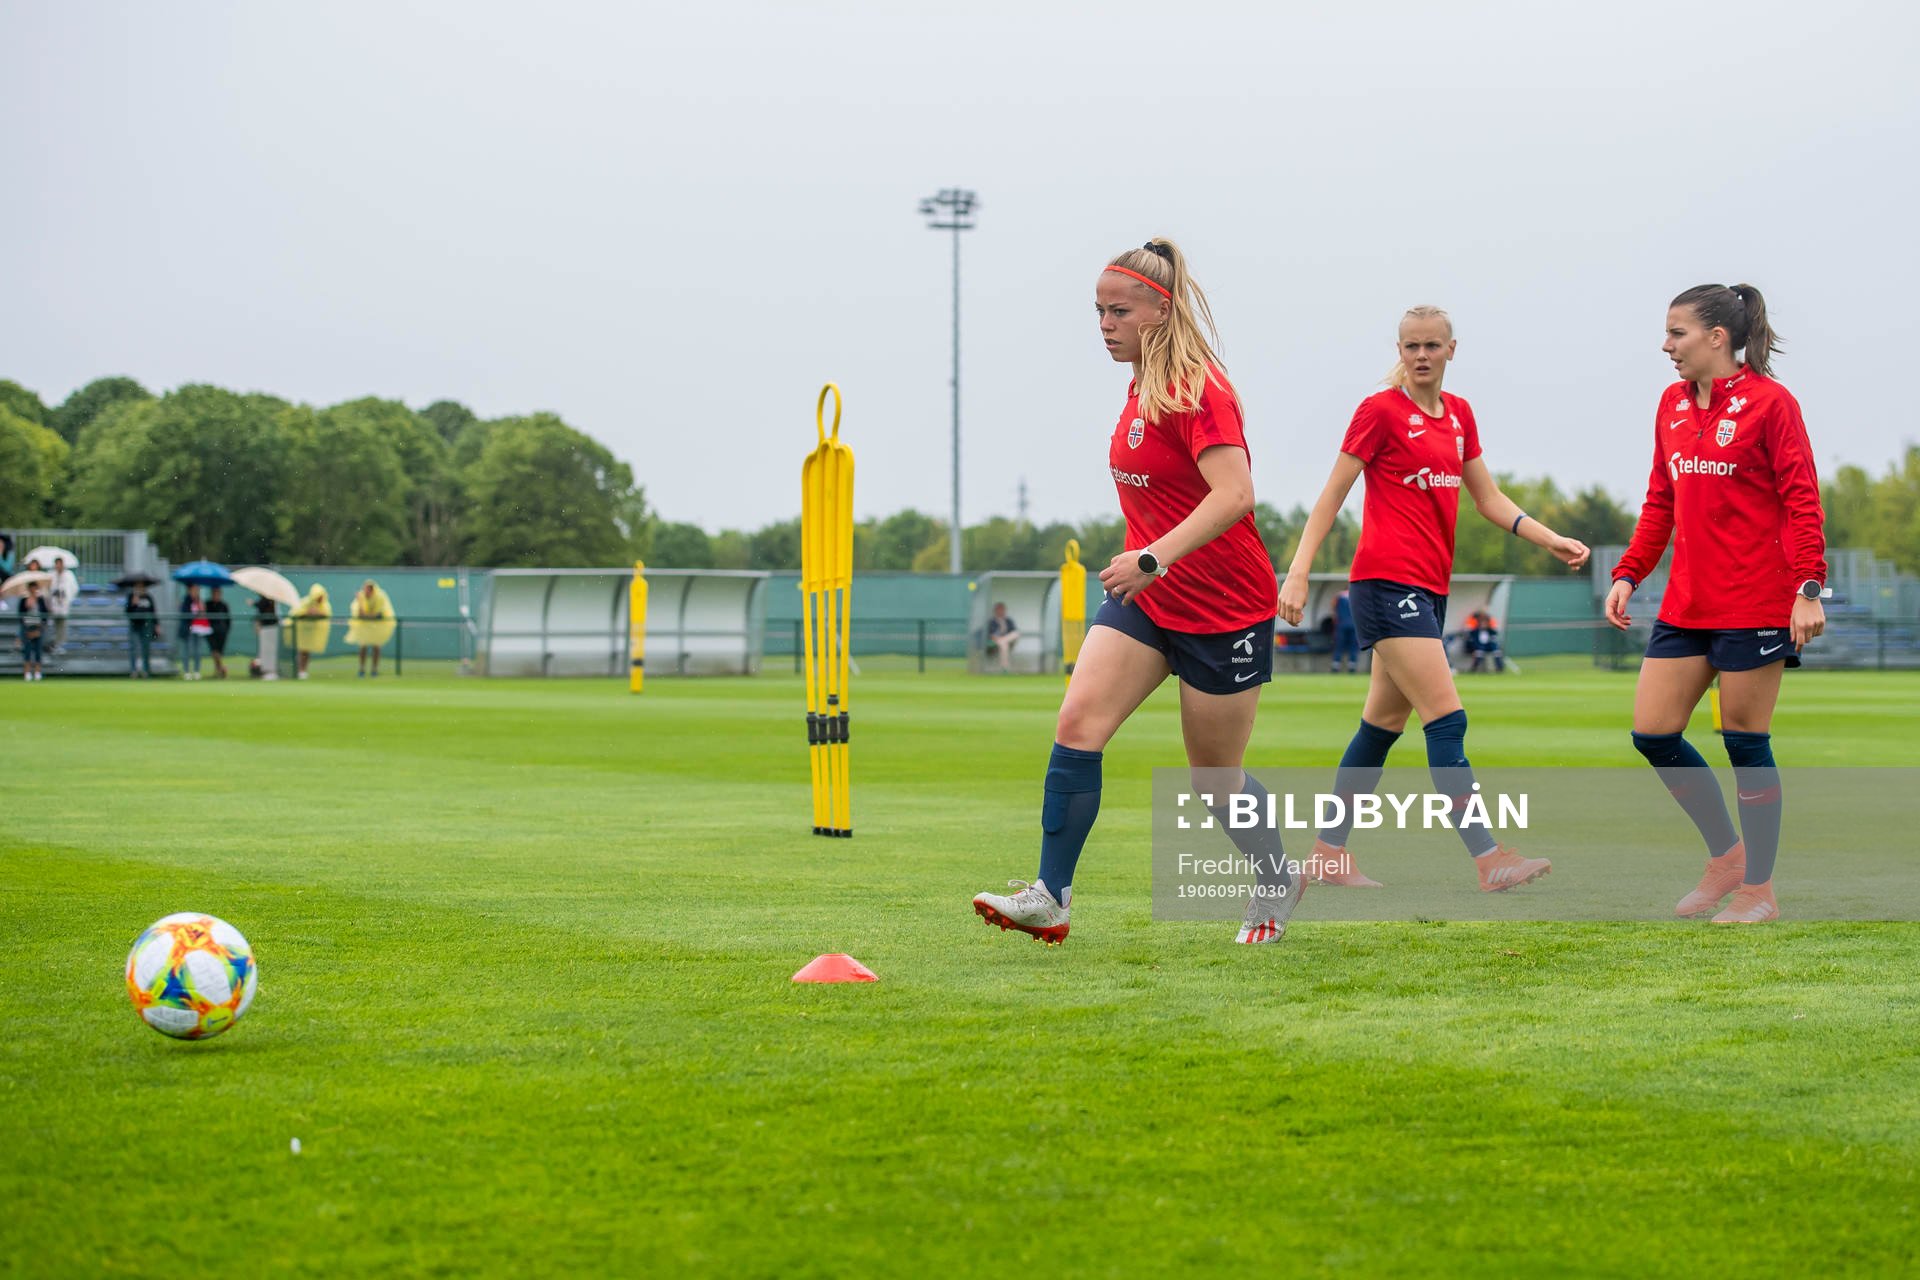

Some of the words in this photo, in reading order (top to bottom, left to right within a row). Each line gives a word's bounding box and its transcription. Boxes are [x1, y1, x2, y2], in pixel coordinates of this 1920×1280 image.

[1678, 455, 1738, 476] telenor
[1757, 629, 1779, 637] telenor
[1231, 656, 1254, 664] telenor
